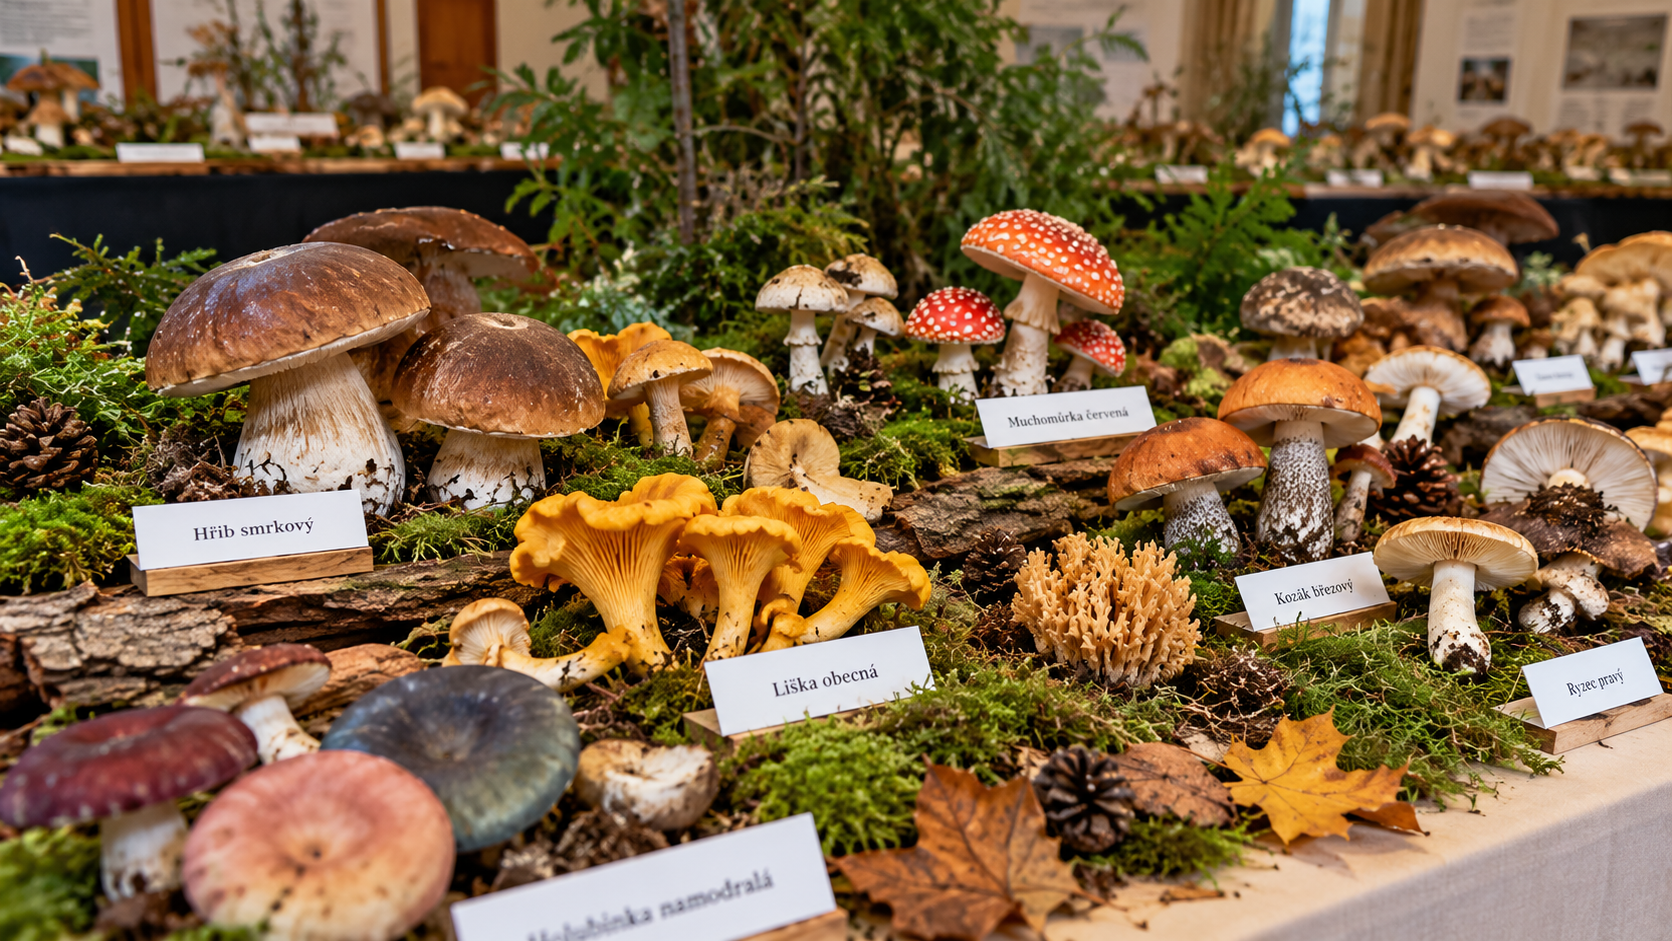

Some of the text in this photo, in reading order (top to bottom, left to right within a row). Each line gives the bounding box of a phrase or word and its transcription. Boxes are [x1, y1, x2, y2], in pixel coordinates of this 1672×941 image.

[1007, 406, 1129, 428] Muchomůrka červená
[193, 516, 314, 541] Hřib smrkový
[1274, 578, 1353, 605] Kozák březový
[772, 663, 879, 697] Liška obecná
[1566, 667, 1624, 697] Ryzec pravý
[660, 867, 774, 918] namodralá
